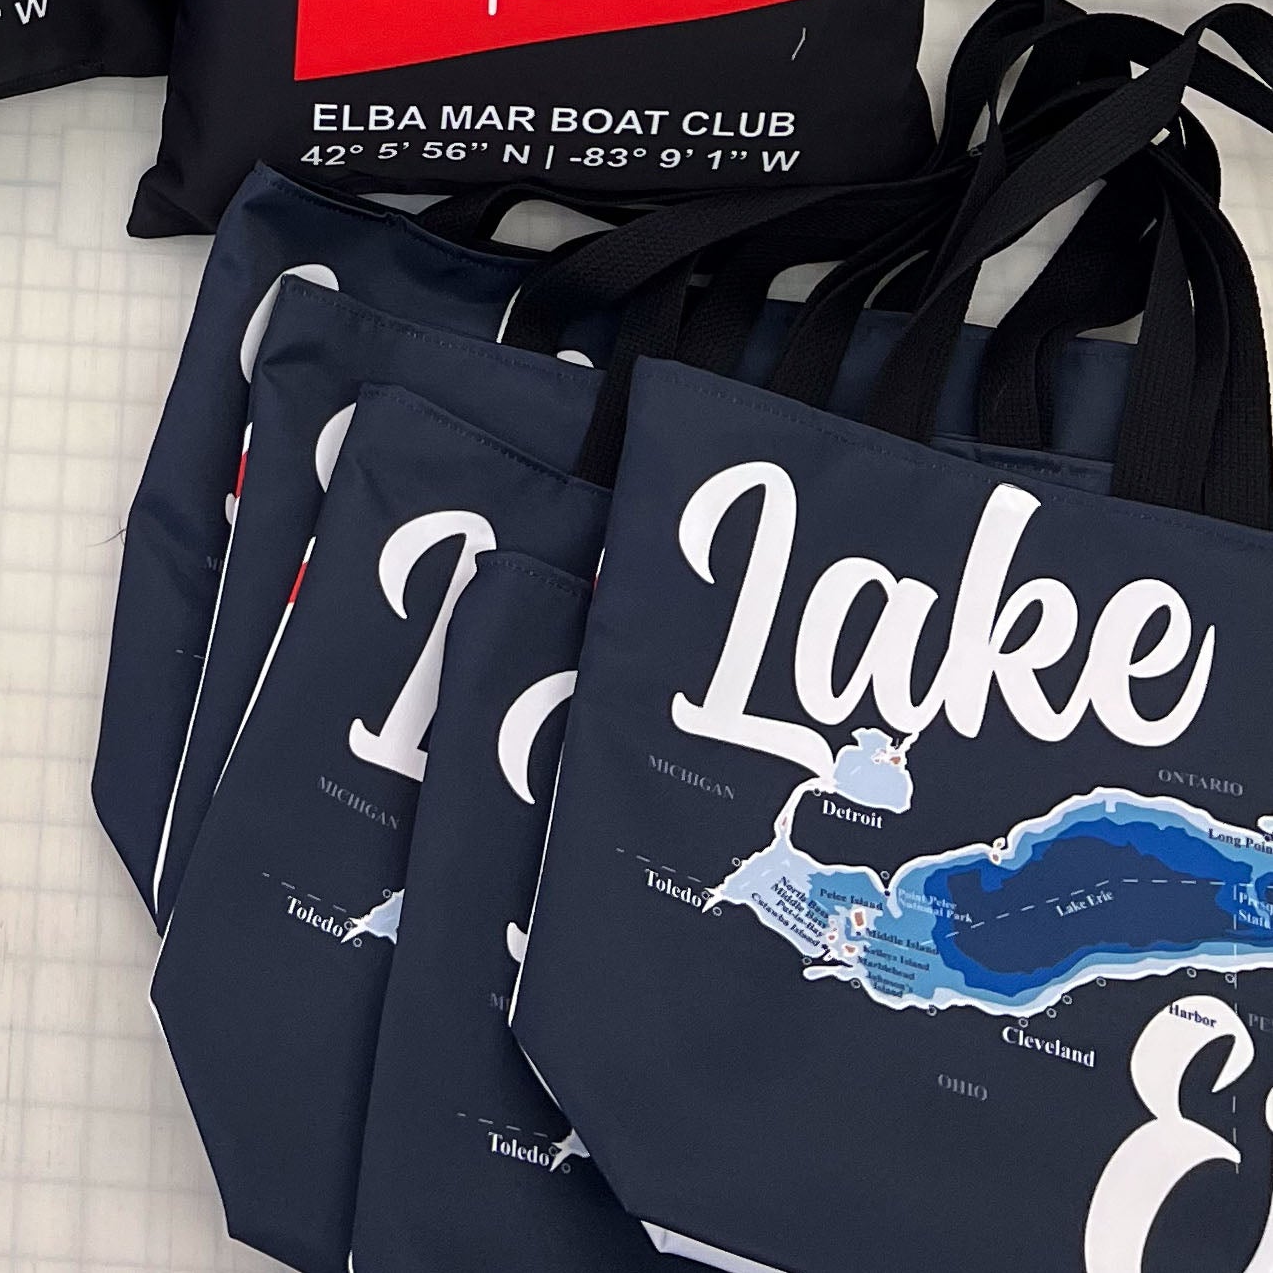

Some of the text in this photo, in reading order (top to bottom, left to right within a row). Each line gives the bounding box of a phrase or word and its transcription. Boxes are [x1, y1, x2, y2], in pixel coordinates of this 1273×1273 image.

[312, 103, 796, 138] ELBA MAR BOAT CLUB
[300, 144, 364, 166] 42°
[502, 143, 531, 165] N
[761, 149, 801, 173] W
[671, 461, 1216, 782] Lake
[647, 754, 736, 800] MICHIGAN
[1157, 769, 1244, 797] ONTARIO
[317, 776, 401, 830] MICHIGAN
[822, 799, 884, 829] Detroit
[1208, 828, 1273, 855] Long Poin
[645, 868, 703, 908] Toledo
[286, 895, 344, 939] Toledo
[1056, 900, 1087, 917] Lake
[1169, 1004, 1218, 1028] Harbor
[1002, 1026, 1096, 1068] Cleveland
[937, 1072, 989, 1101] OHIO
[487, 1131, 551, 1168] Toledo
